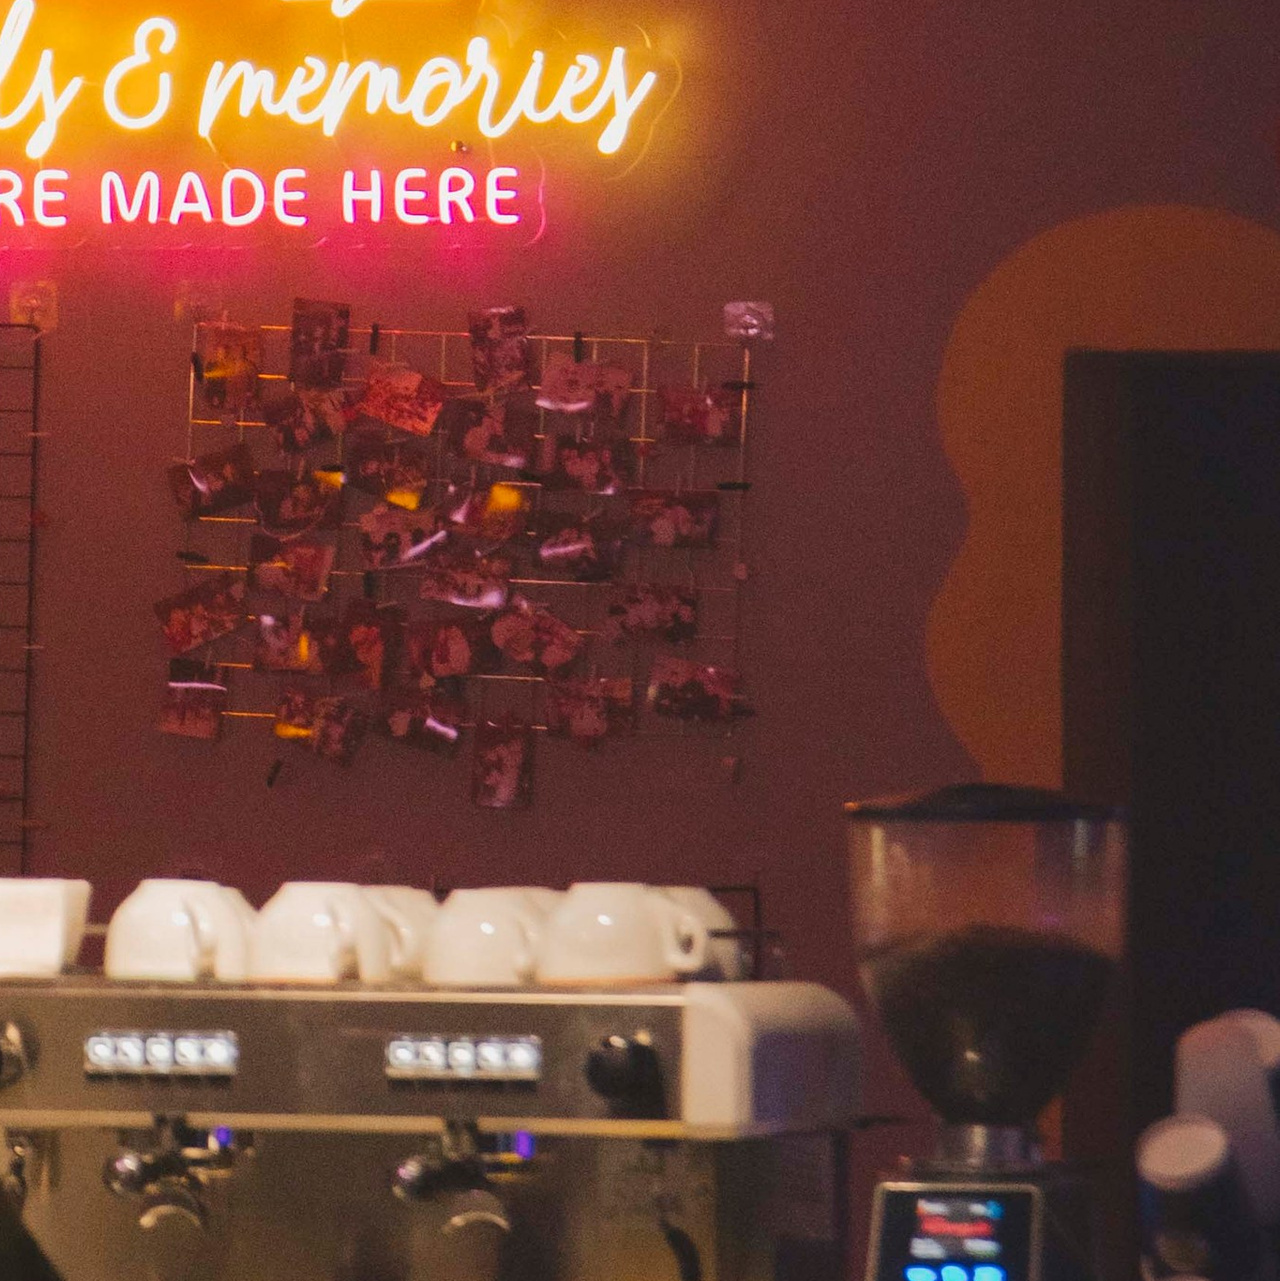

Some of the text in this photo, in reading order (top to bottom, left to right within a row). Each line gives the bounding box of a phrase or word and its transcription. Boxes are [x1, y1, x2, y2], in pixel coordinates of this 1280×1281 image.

[104, 17, 176, 129] &
[199, 36, 657, 153] memories
[100, 169, 308, 227] MADE
[341, 167, 521, 225] HERE
